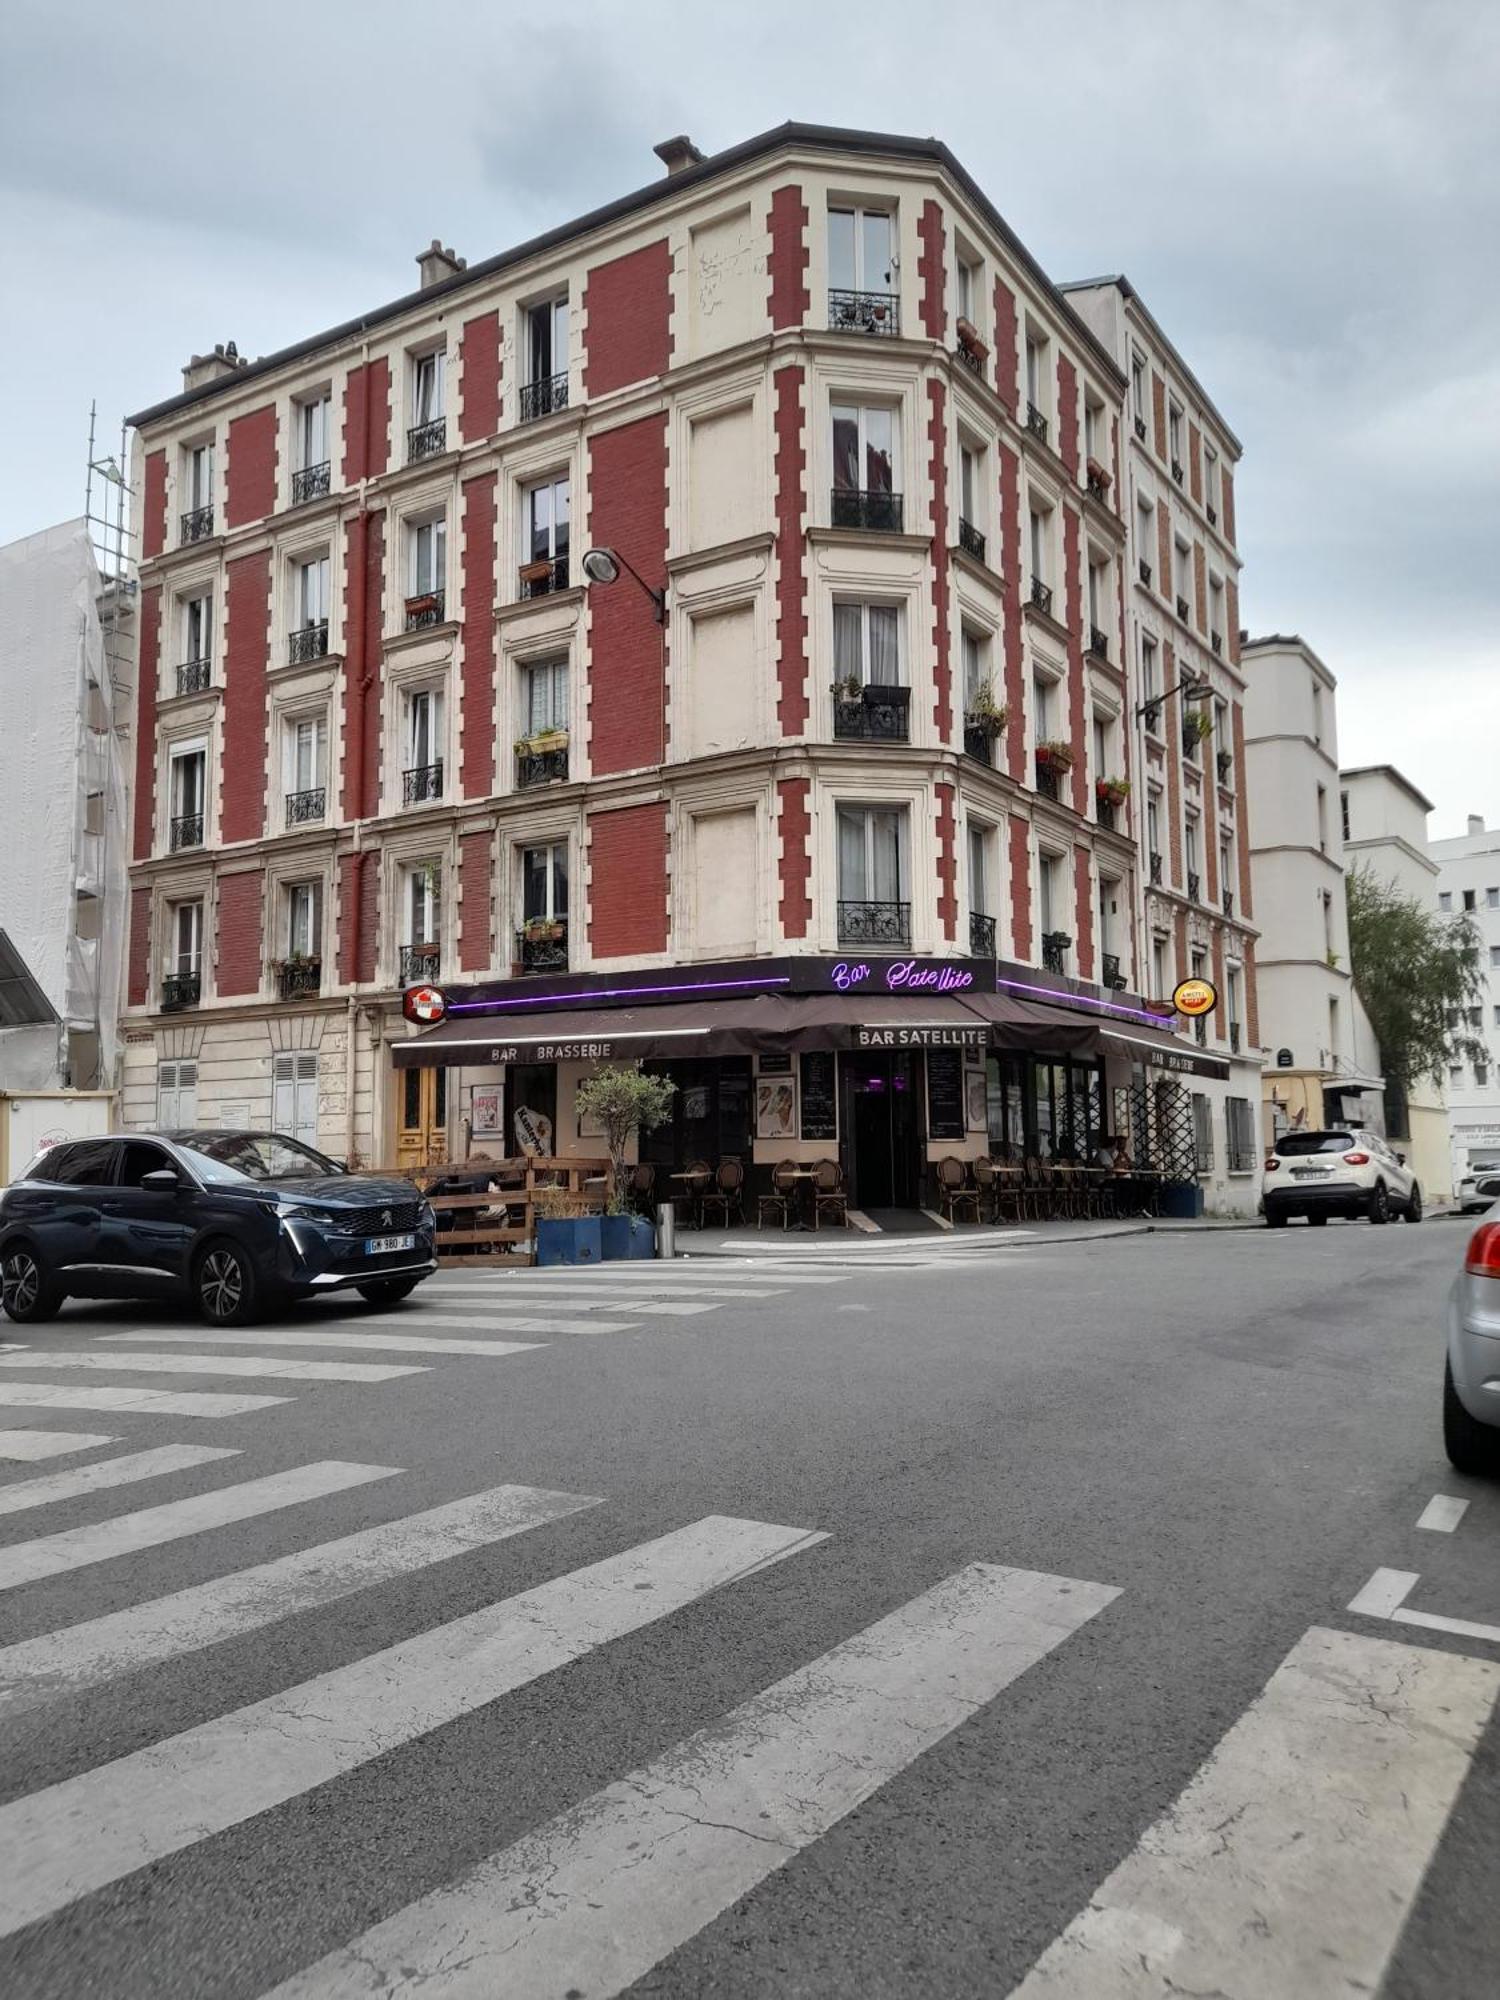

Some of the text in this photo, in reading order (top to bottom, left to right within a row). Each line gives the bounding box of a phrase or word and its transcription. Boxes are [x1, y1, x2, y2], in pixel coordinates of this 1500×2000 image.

[832, 960, 973, 991] Bar Satellite
[859, 1030, 987, 1045] BAR SATELLITE
[491, 1043, 611, 1061] BAR BRASSERIE
